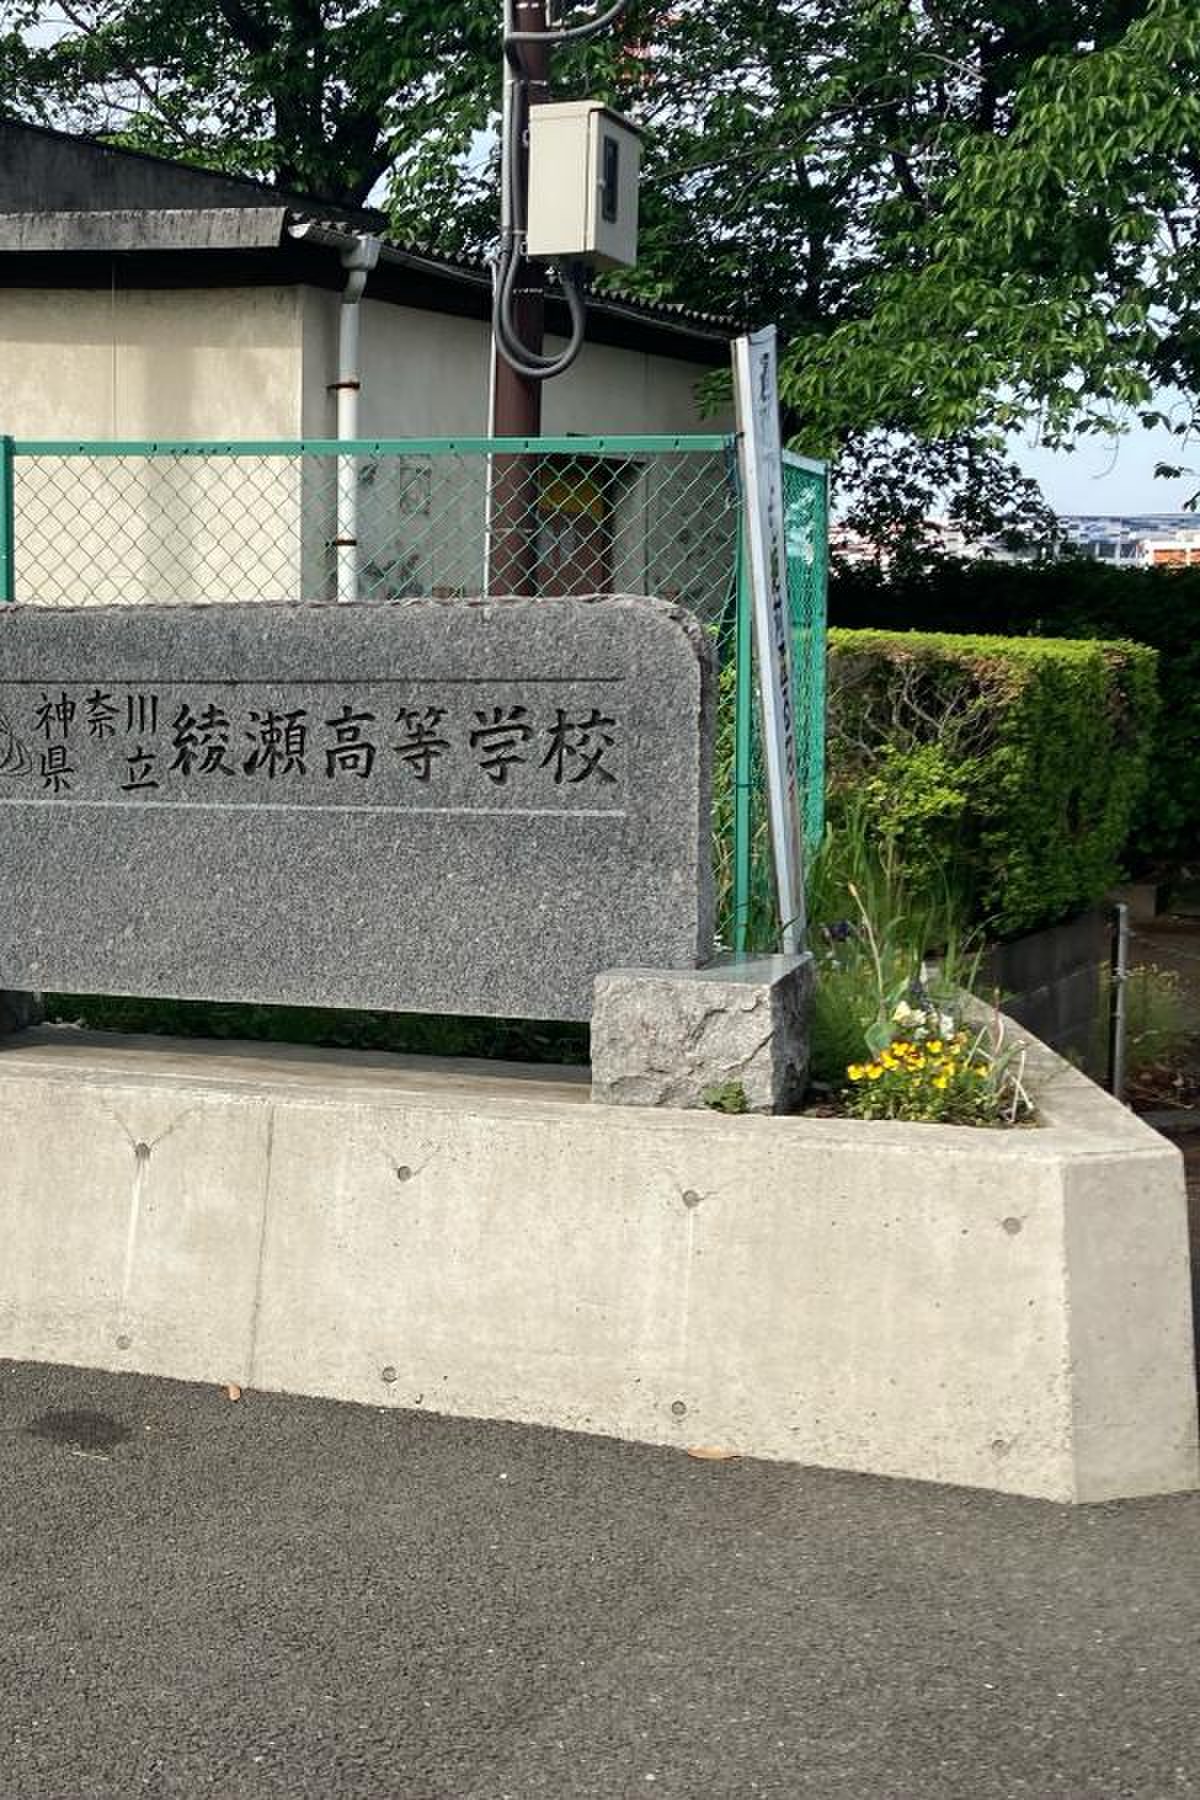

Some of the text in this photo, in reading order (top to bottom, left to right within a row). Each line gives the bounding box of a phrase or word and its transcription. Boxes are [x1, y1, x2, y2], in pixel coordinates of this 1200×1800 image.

[35, 688, 159, 741] 神奈川
[168, 703, 618, 786] 綾瀬高等学校
